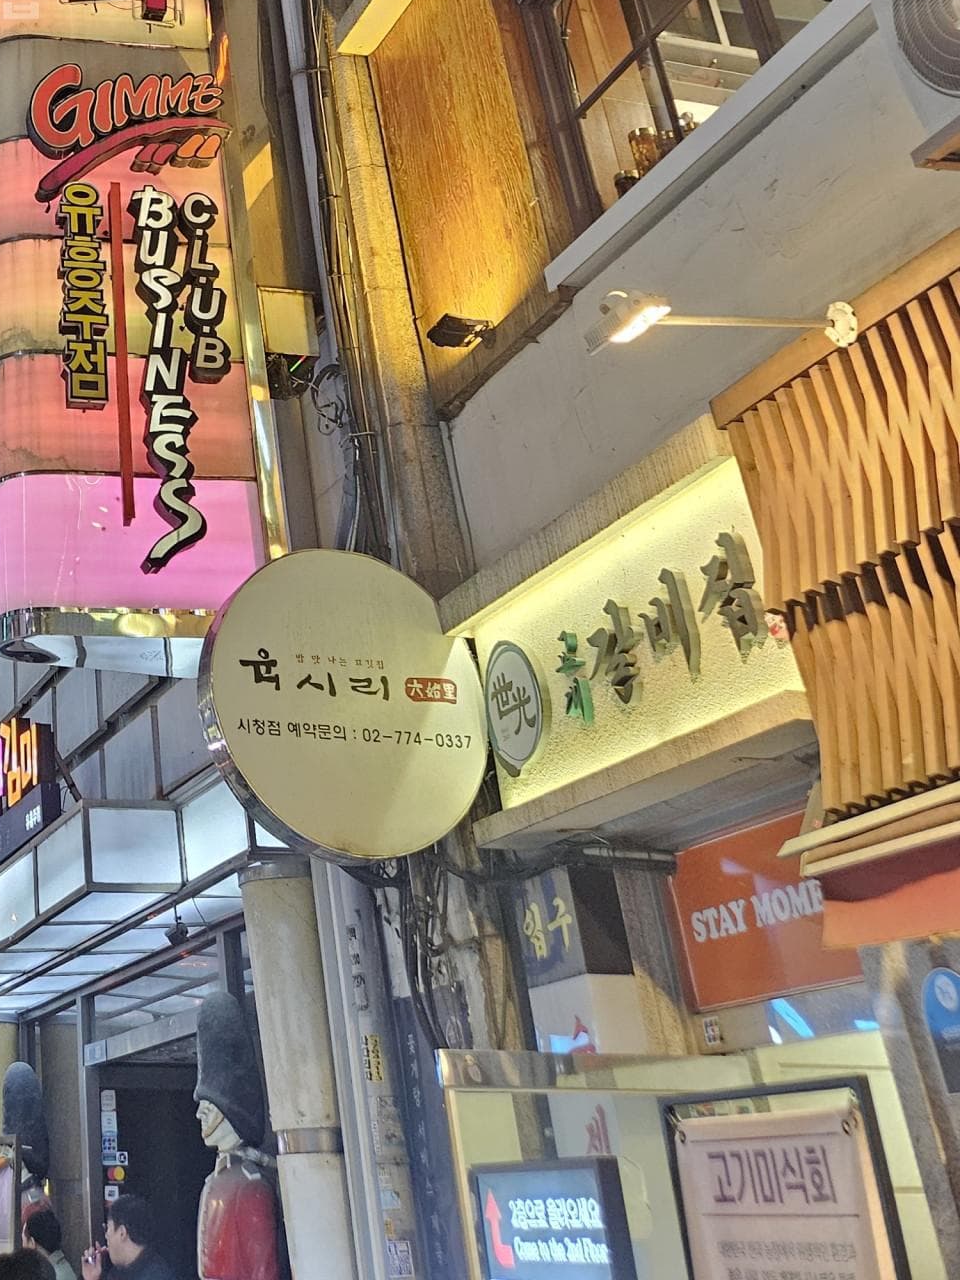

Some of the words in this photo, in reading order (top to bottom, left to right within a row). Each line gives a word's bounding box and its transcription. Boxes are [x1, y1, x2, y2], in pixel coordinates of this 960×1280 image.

[29, 63, 225, 150] GIMME
[60, 183, 107, 401] 유흥주점
[134, 185, 206, 571] BUSINESS
[239, 648, 390, 701] 육시리
[406, 679, 457, 701] 六始里
[490, 672, 537, 736] 世光
[237, 718, 281, 737] 시청점
[287, 722, 347, 740] 예약문의
[362, 727, 472, 749] 02-774-0337
[523, 896, 573, 960] 입구
[691, 899, 748, 943] STAY
[707, 1144, 838, 1205] 고기미식회
[514, 1236, 540, 1262] Come
